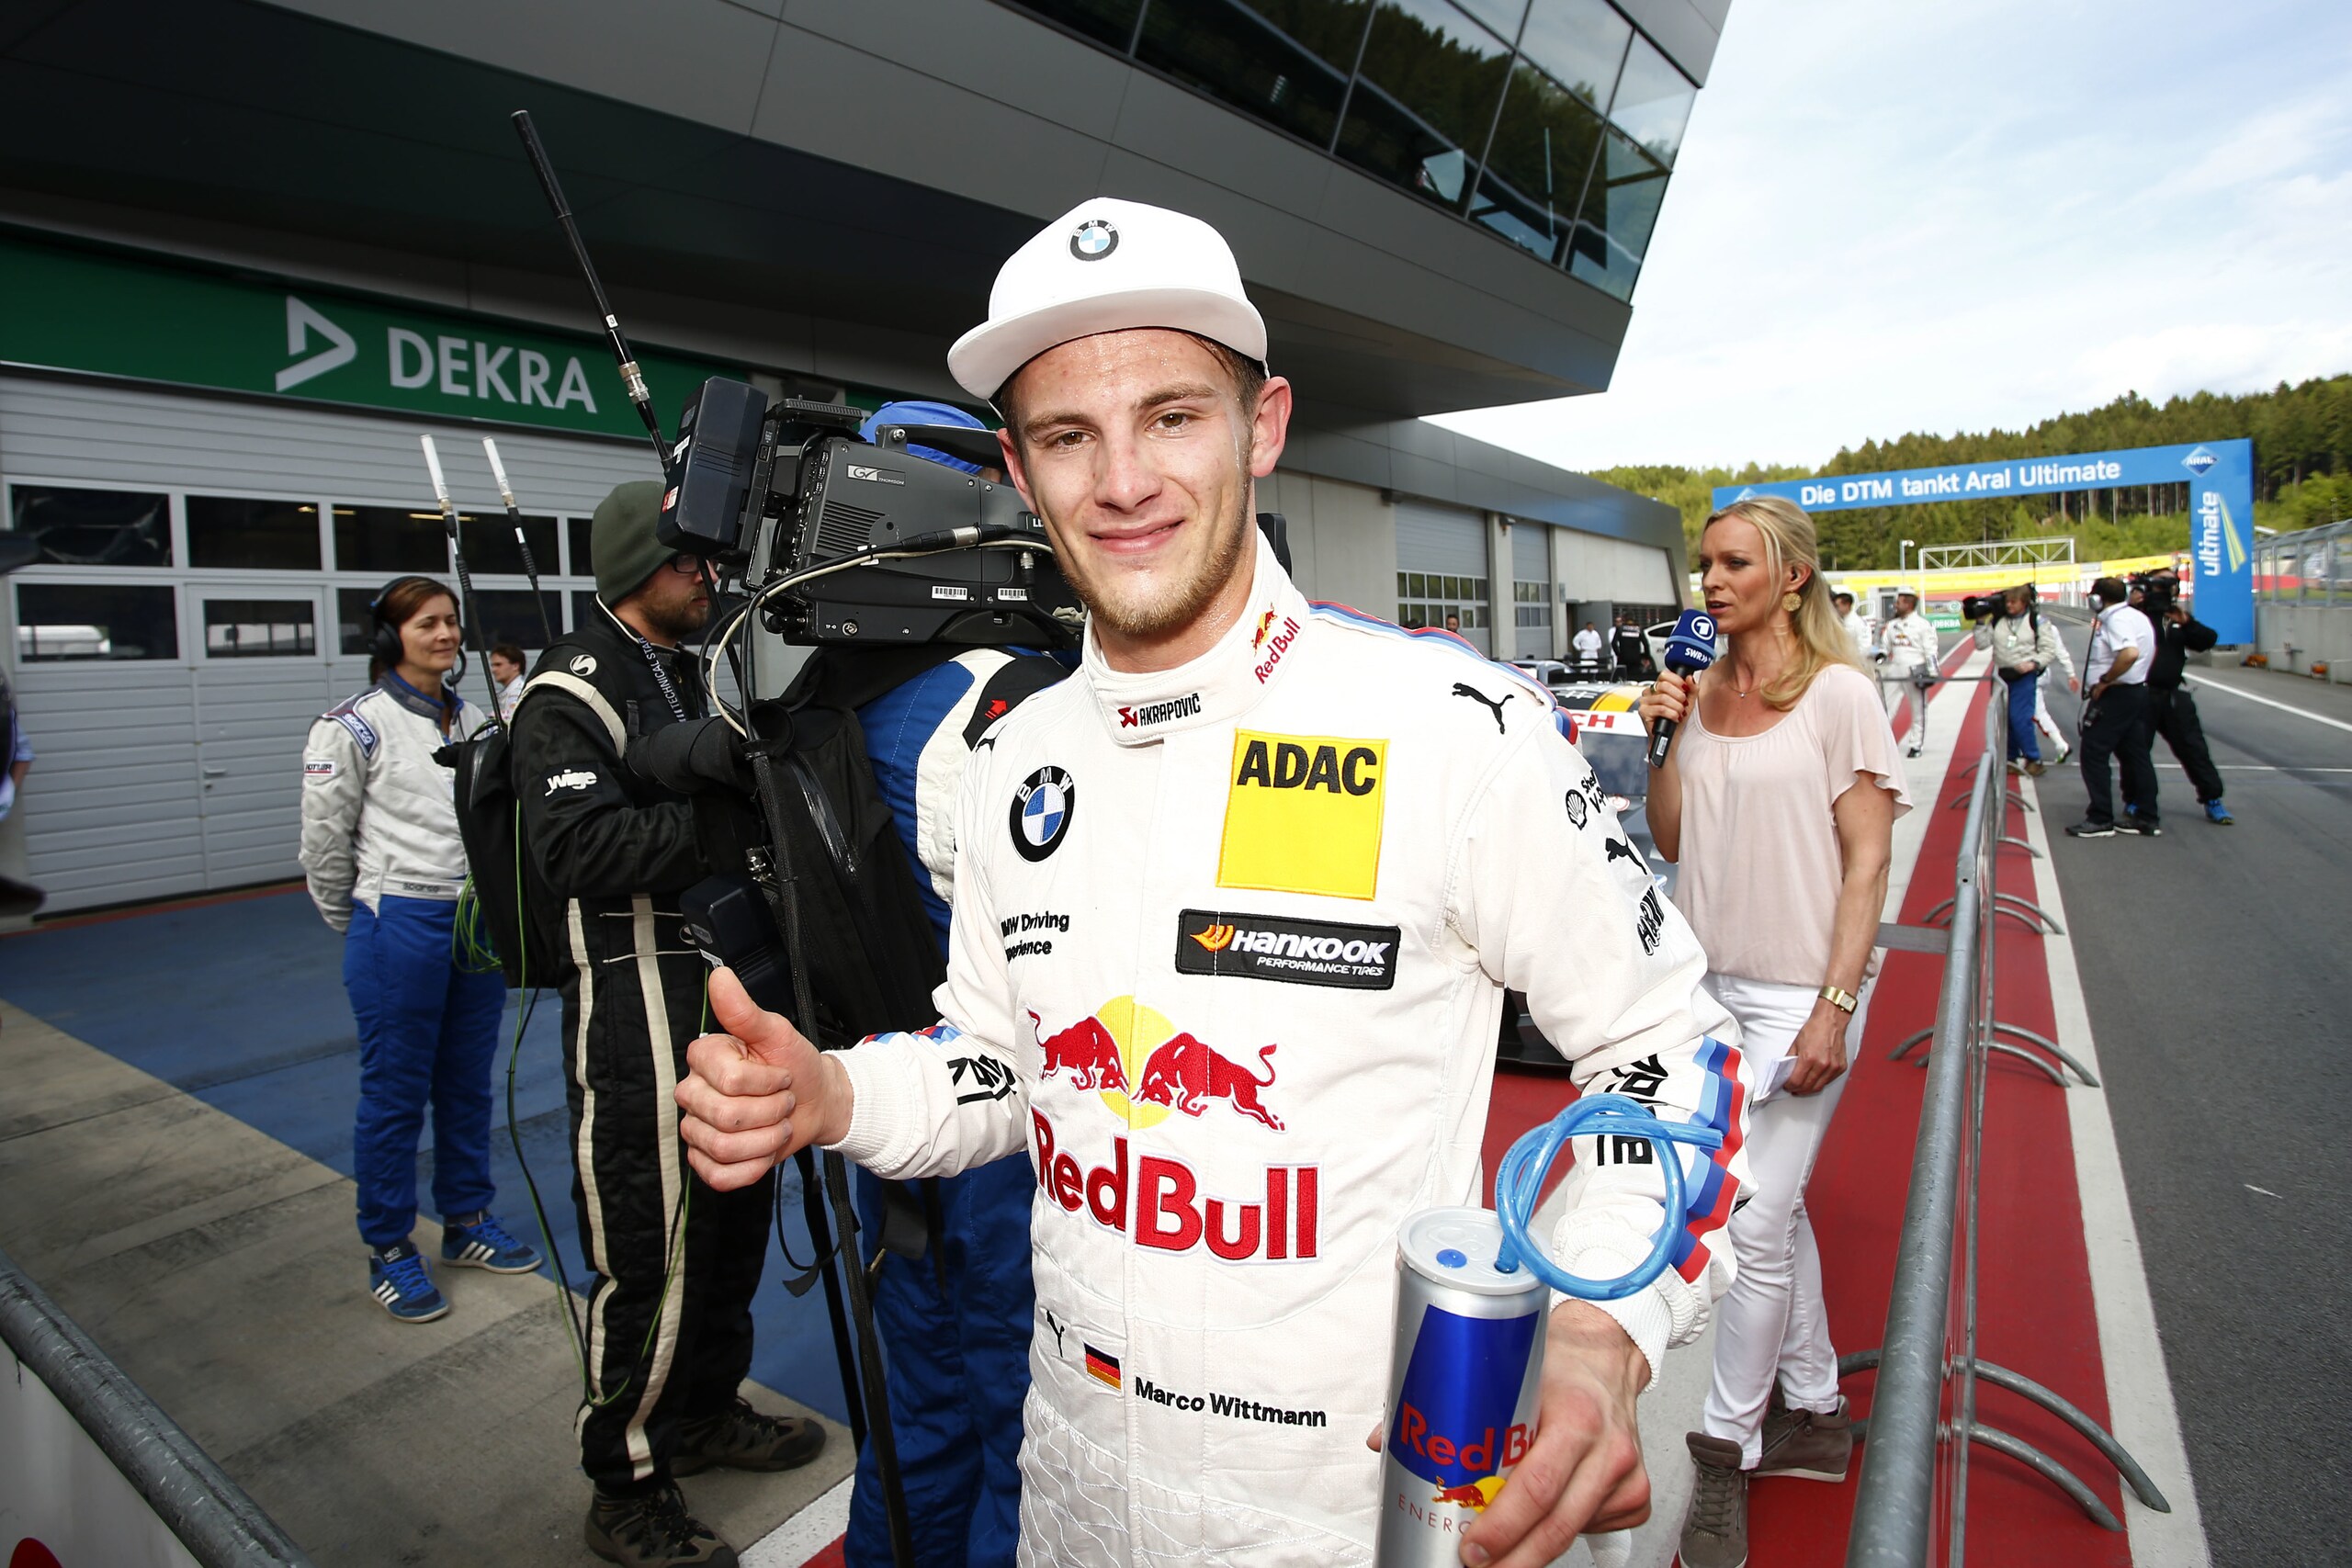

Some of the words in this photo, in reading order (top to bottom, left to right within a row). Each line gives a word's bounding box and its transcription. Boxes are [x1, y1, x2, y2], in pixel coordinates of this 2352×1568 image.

[387, 326, 598, 414] DEKRA
[877, 477, 905, 486] THOMSON
[1801, 484, 1836, 506] Die
[1841, 479, 1893, 502] DTM
[1900, 471, 1961, 498] tankt
[1965, 467, 2011, 492] Aral
[2018, 459, 2122, 487] Ultimate
[2185, 455, 2215, 466] ARAL
[2198, 491, 2221, 577] ultimate
[1255, 644, 1281, 685] Red
[1272, 616, 1301, 653] Bull
[650, 660, 680, 709] TECHNICAL
[1139, 692, 1202, 727] AKRAPOVIČ
[1016, 766, 1073, 803] BMW
[1237, 739, 1377, 796] ADAC
[1021, 910, 1069, 932] Driving
[1256, 955, 1351, 976] PERFORMANCE
[1352, 965, 1385, 977] TIRES
[1031, 1105, 1128, 1233] Red
[1135, 1154, 1318, 1261] Bull
[1135, 1376, 1205, 1412] Marco
[1209, 1392, 1328, 1427] Wittmann
[1400, 1401, 1496, 1472] Red
